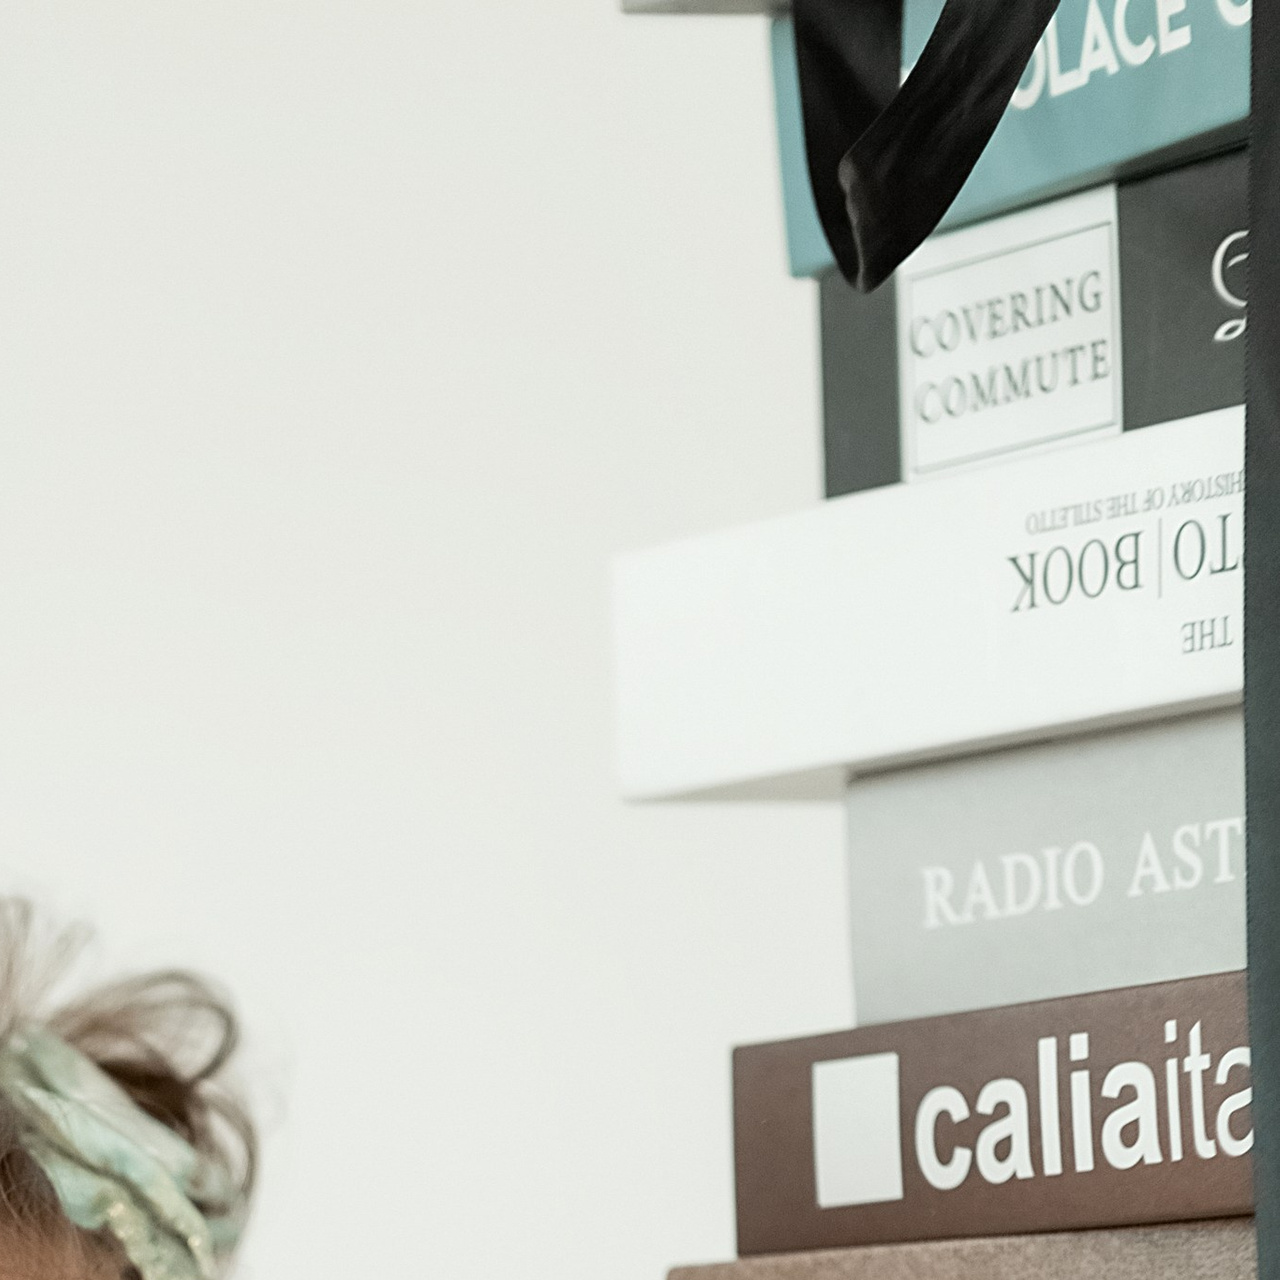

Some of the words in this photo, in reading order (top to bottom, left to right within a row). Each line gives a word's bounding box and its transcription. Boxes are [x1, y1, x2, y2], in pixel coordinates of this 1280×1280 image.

[909, 269, 1104, 358] COVERING
[915, 339, 1111, 424] COMMUTE
[1025, 499, 1103, 535] STILETTO
[1107, 491, 1138, 520] THE
[1143, 487, 1166, 513] OF
[1007, 530, 1144, 613] BOOK
[1174, 512, 1240, 581] TO
[1180, 615, 1235, 654] THE
[921, 841, 1104, 930] RADIO
[1127, 817, 1246, 898] AST
